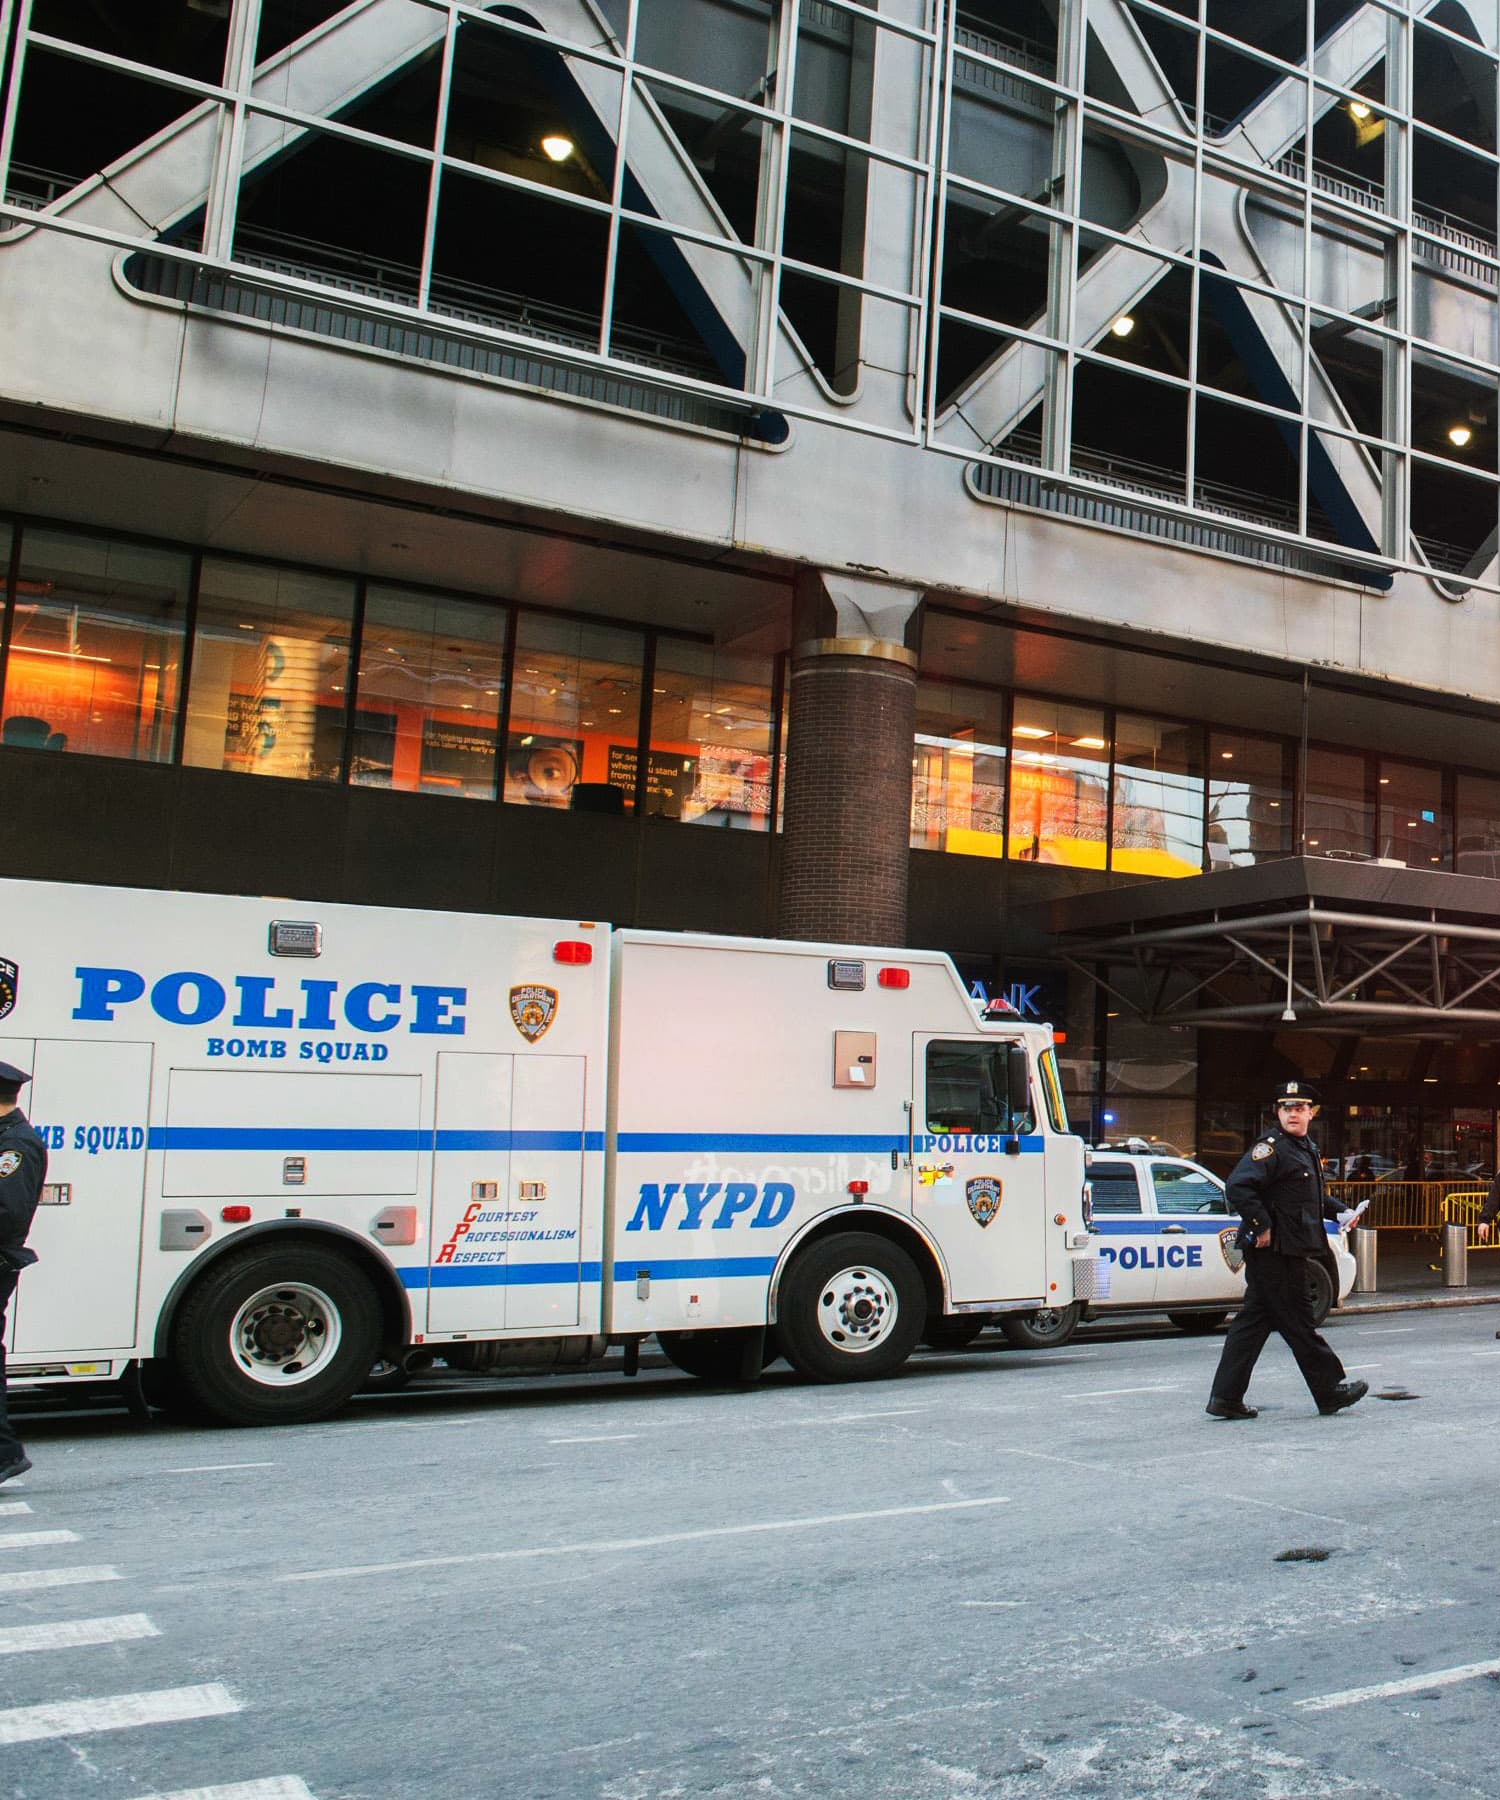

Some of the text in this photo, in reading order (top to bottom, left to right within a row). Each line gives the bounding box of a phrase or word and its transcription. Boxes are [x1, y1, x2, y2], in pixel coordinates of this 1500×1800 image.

[656, 767, 678, 777] stand
[72, 966, 467, 1035] POLICE
[207, 1038, 389, 1063] BOMB SQUAD
[34, 1126, 145, 1154] MB SQUAD
[923, 1135, 1000, 1153] POLICE
[626, 1183, 796, 1231] NYPD
[450, 1223, 577, 1242] PROFESSIONALISM
[435, 1244, 506, 1263] RESPECT
[1099, 1245, 1204, 1270] POLICE
